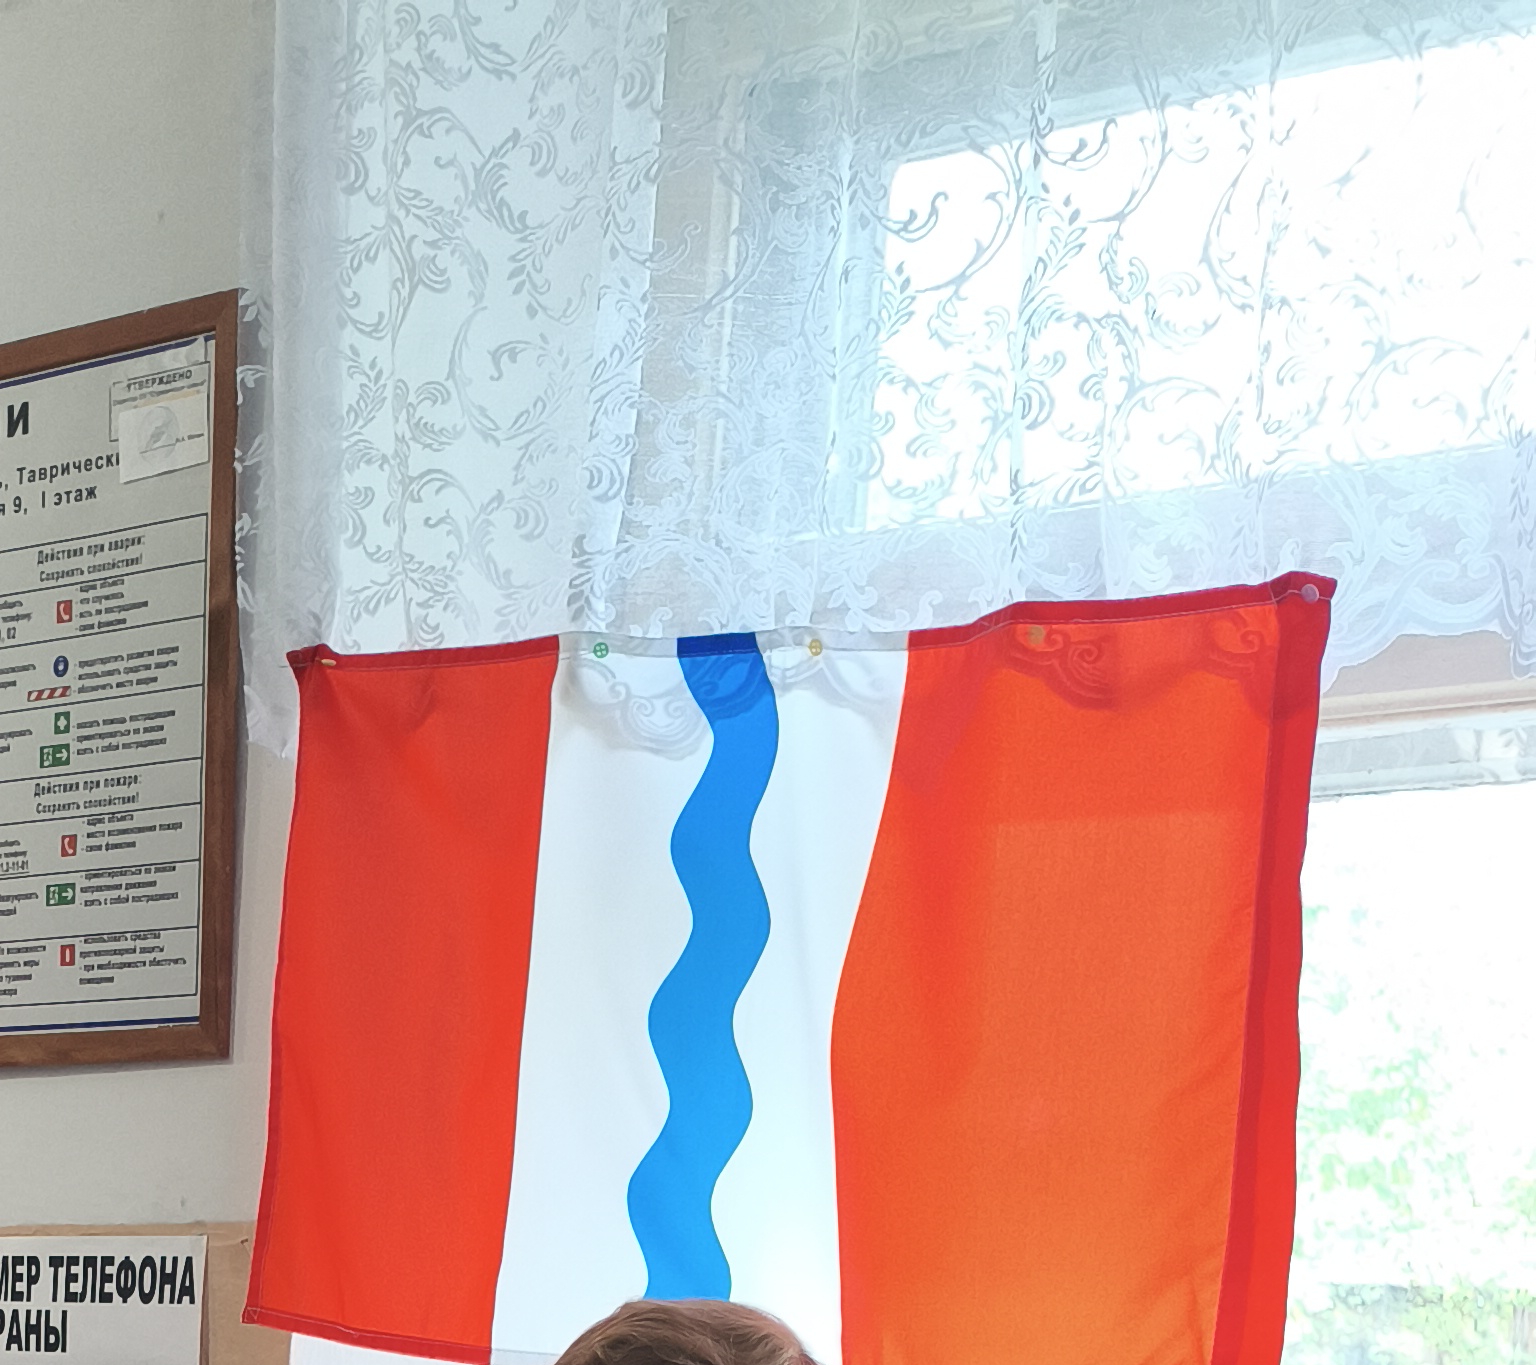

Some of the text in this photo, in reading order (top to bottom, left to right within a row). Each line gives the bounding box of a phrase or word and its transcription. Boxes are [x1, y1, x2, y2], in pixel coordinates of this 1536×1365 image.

[13, 496, 28, 516] 9,
[54, 485, 98, 507] этаж
[49, 1255, 196, 1305] ТЕЛЕФОНА
